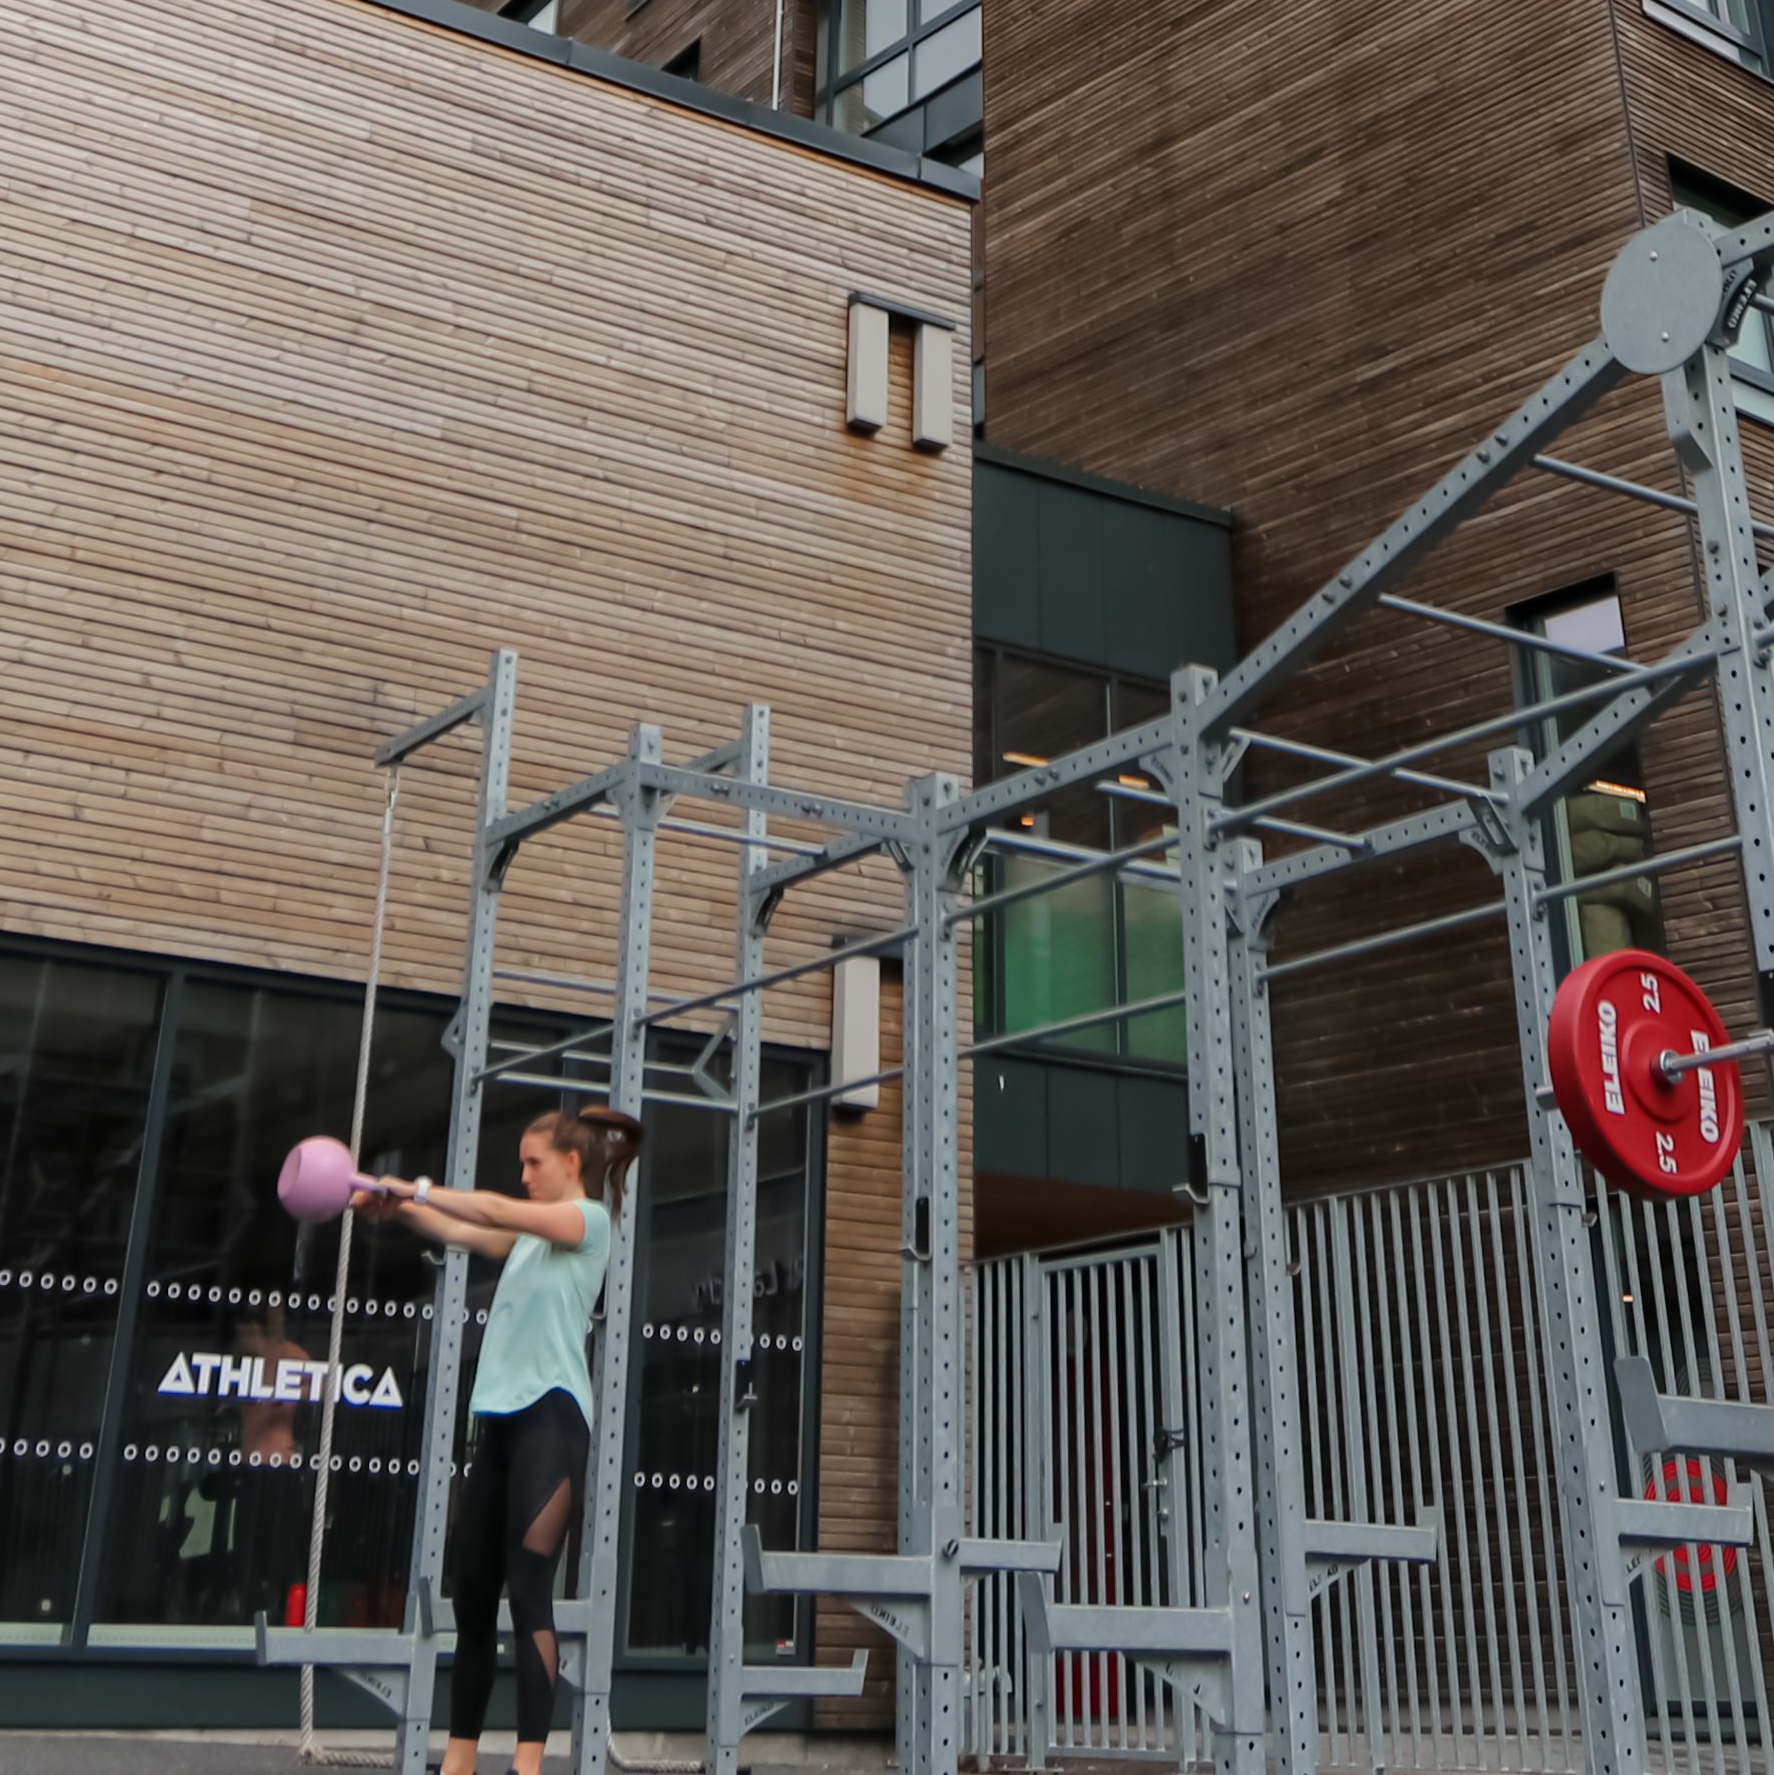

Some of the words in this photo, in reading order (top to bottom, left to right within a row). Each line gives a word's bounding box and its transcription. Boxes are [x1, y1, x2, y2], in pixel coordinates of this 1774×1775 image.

[1597, 1000, 1625, 1115] ELEIKO
[1690, 1029, 1719, 1143] EEIKO
[158, 1352, 403, 1407] ATHLETICA
